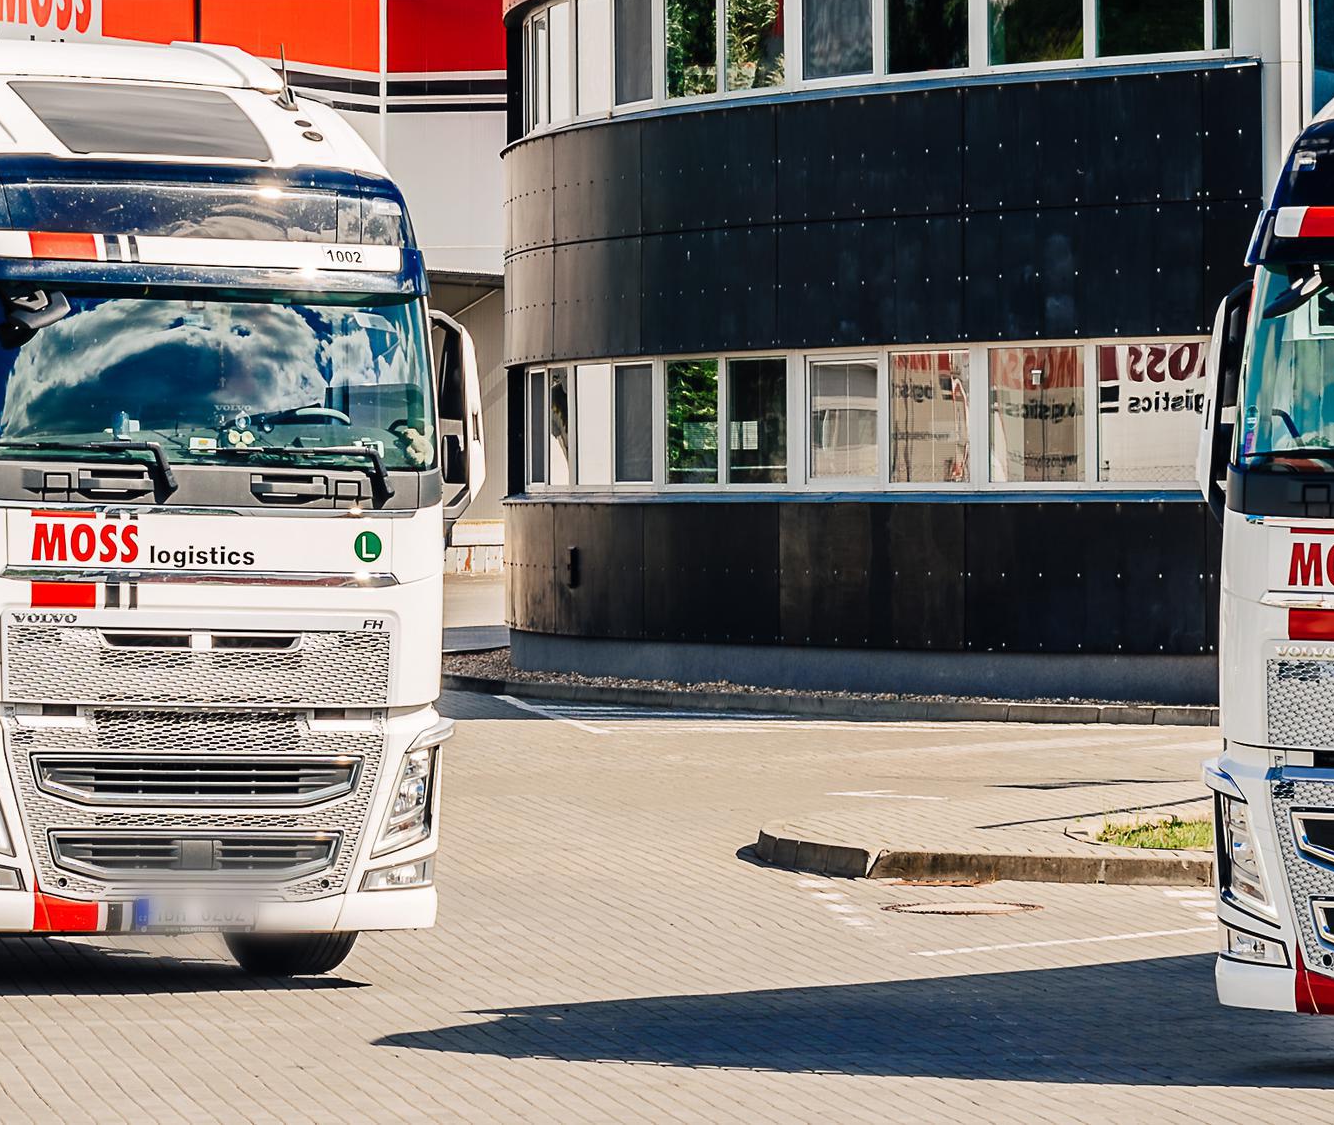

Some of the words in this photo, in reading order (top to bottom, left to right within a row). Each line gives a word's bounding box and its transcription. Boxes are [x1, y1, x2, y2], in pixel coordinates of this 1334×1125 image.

[327, 250, 362, 263] 1002
[214, 404, 252, 412] VOLVO
[31, 523, 139, 563] MOSS
[149, 545, 255, 568] logistics
[362, 535, 376, 558] L
[11, 612, 78, 624] VOLVO
[363, 620, 383, 630] FH
